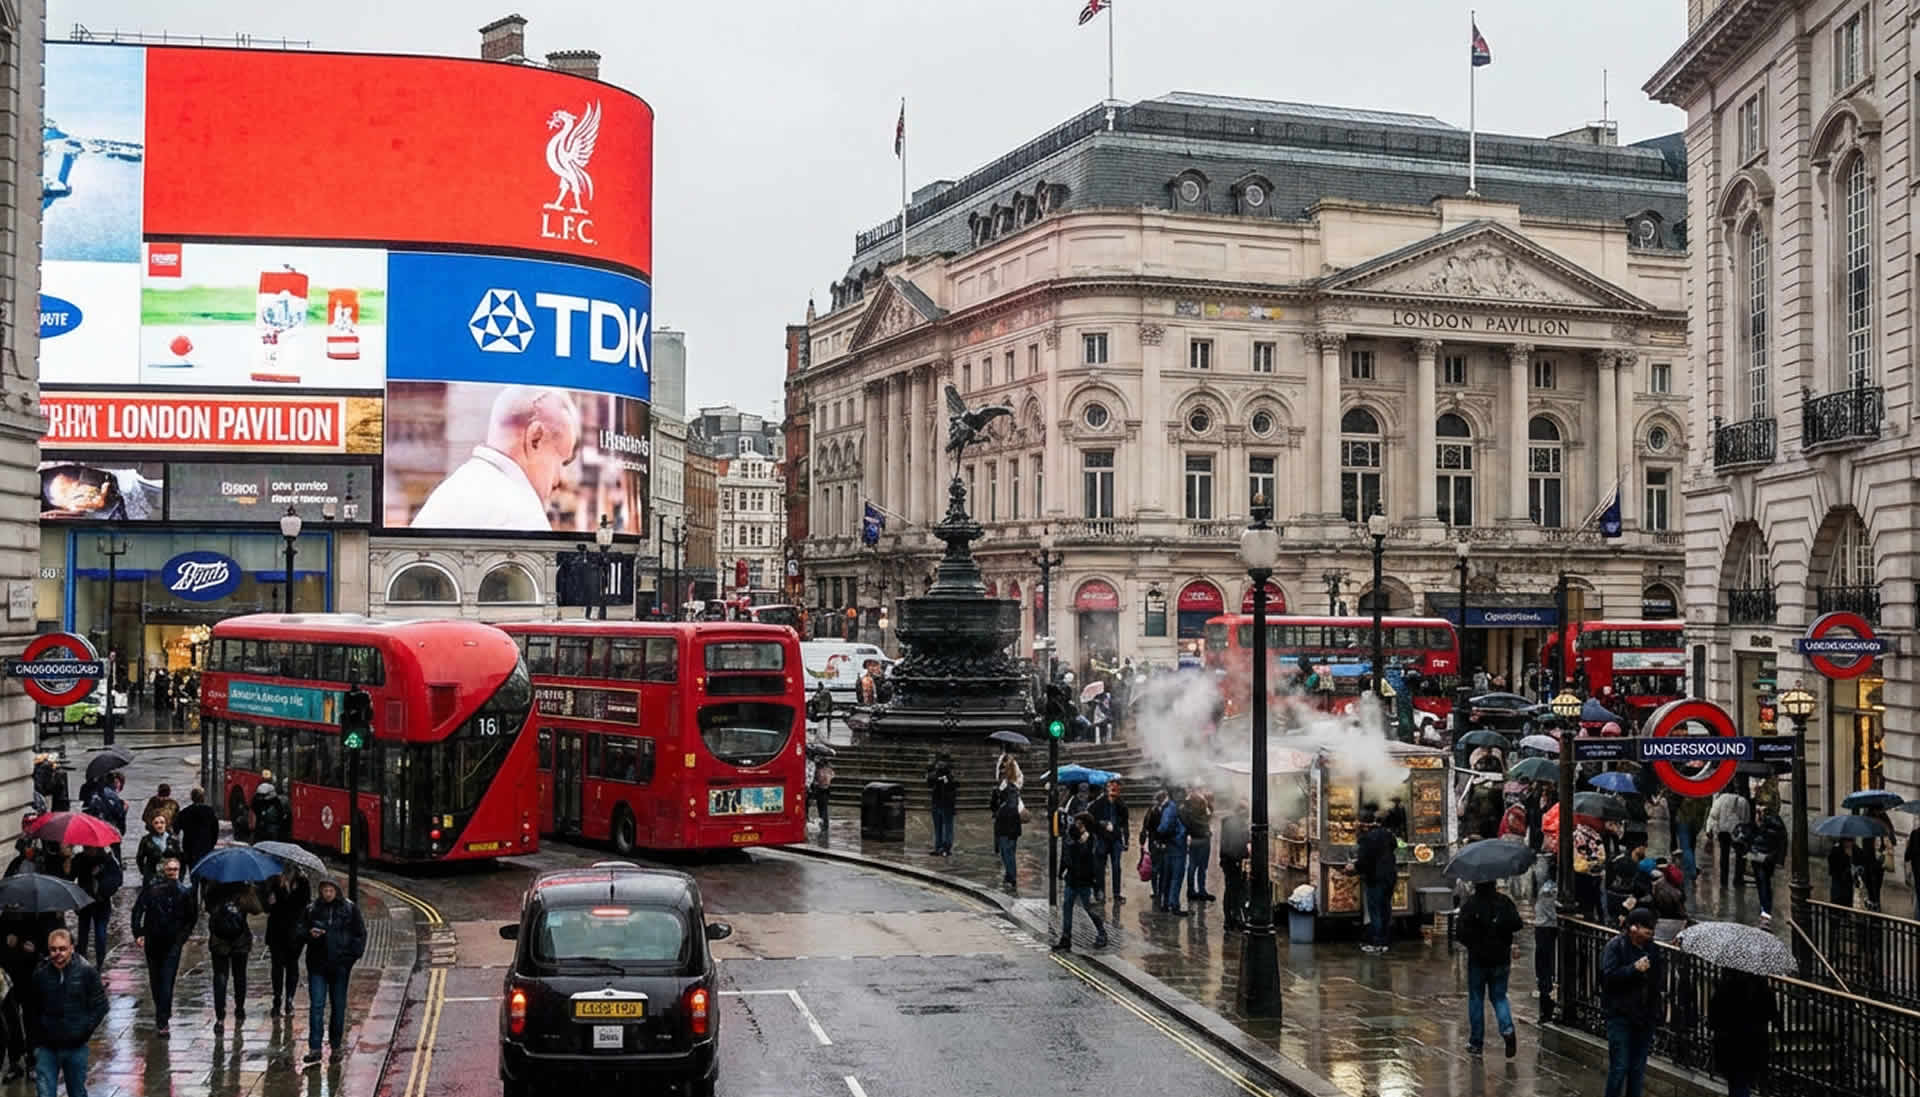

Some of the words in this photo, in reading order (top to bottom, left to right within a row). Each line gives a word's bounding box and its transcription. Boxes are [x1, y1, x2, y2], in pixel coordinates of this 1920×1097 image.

[536, 292, 648, 373] TDK
[1393, 311, 1473, 329] LONDON
[1486, 317, 1569, 335] PAVILION
[107, 404, 211, 439] LONDON
[217, 406, 331, 442] PAVILION
